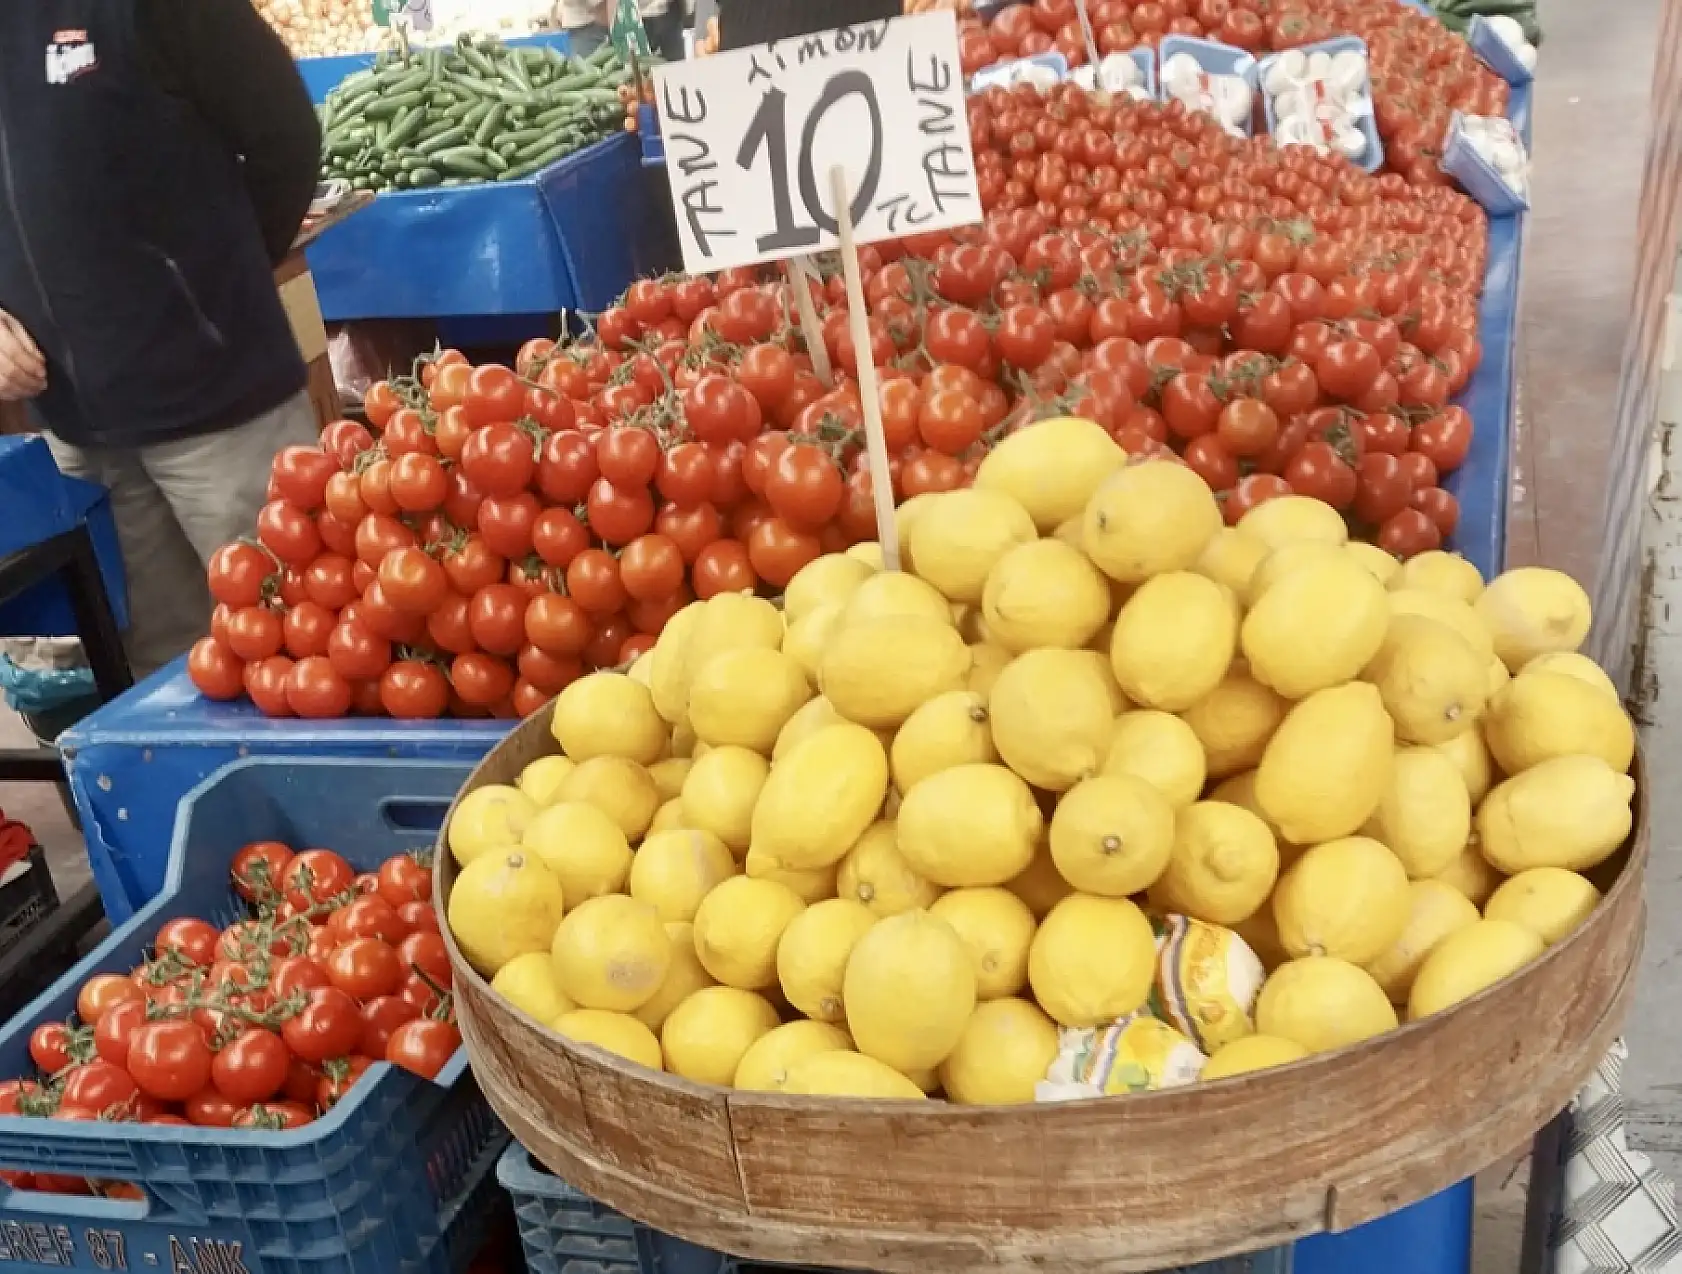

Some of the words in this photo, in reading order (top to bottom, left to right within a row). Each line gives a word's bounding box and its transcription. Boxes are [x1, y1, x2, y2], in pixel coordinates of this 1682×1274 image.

[663, 78, 737, 257] TANE
[736, 69, 883, 253] 10
[907, 44, 971, 213] TANE
